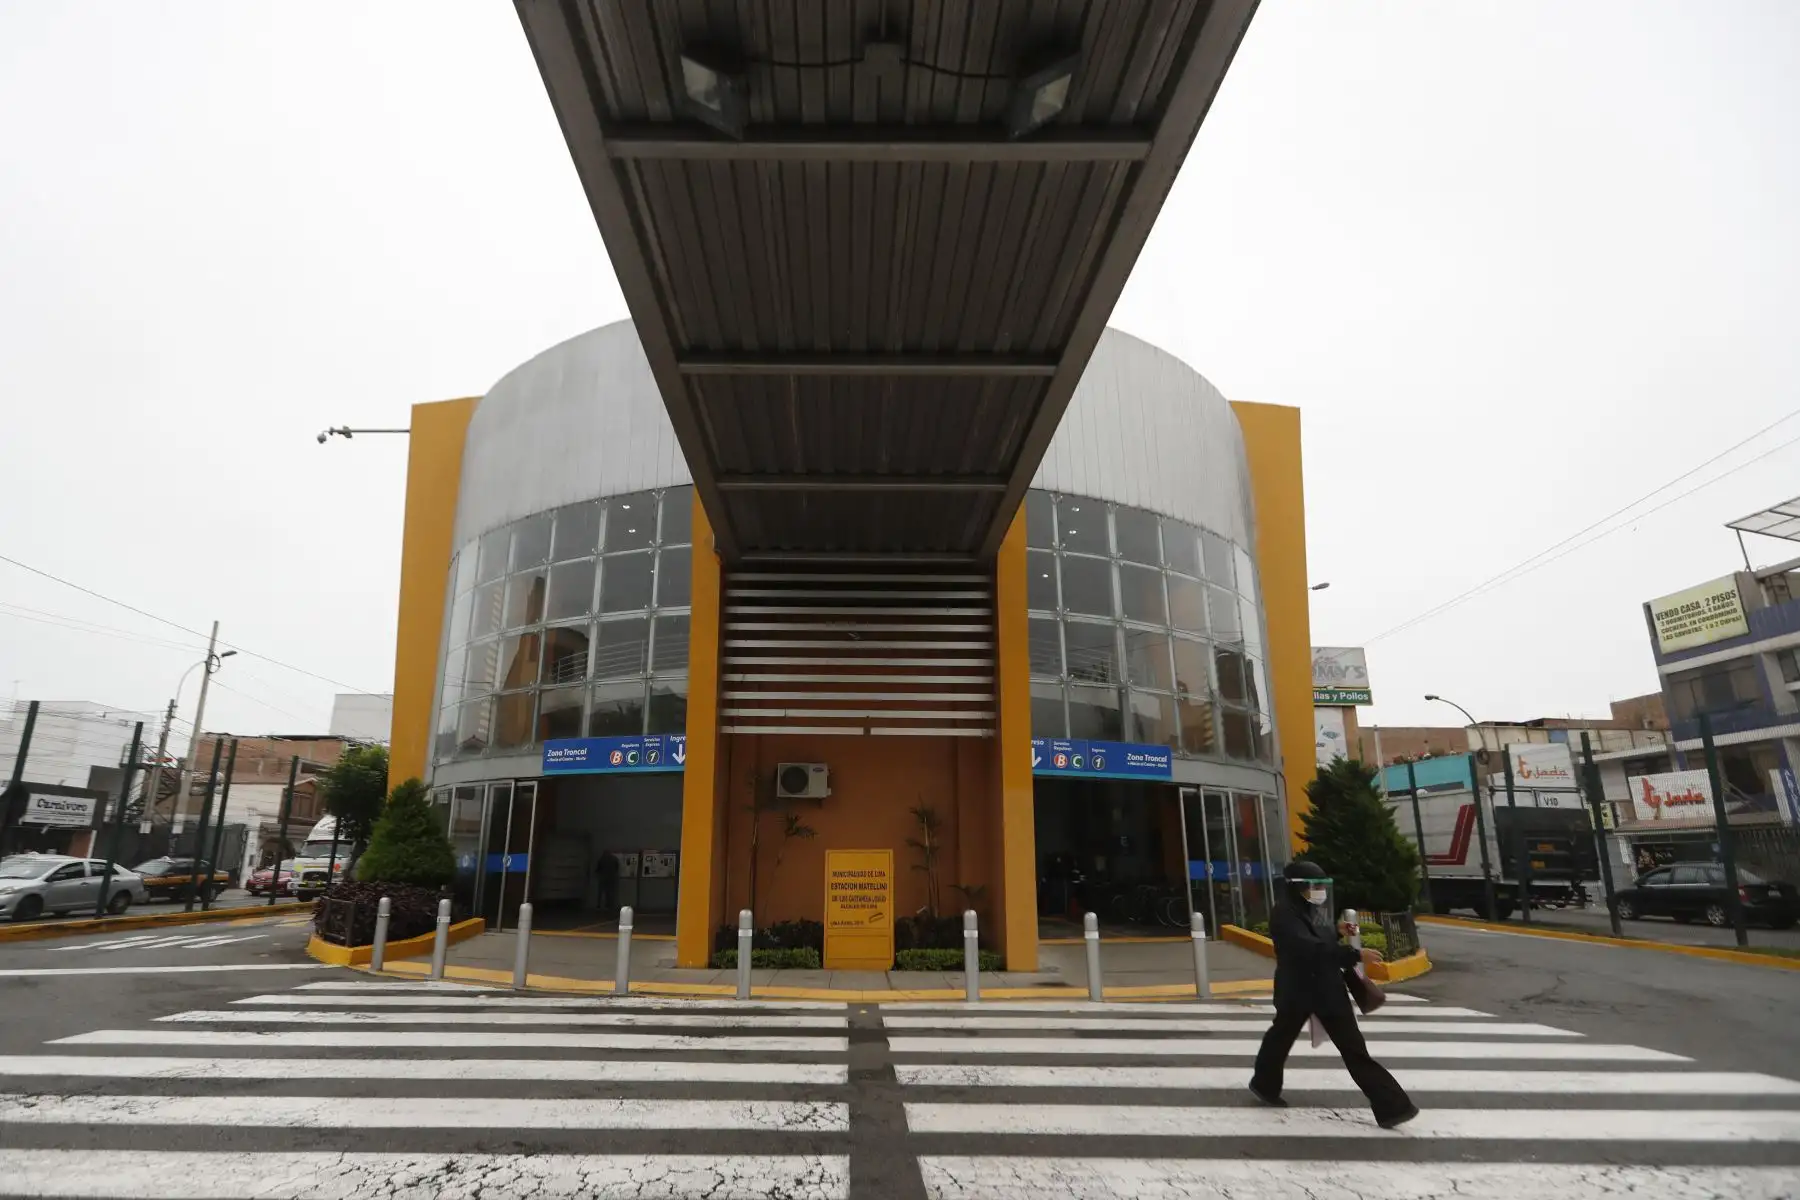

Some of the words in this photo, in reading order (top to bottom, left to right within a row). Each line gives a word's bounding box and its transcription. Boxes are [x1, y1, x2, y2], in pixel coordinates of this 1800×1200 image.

[1655, 607, 1679, 621] VENDO
[1705, 597, 1711, 606] 2
[1711, 589, 1737, 605] PISOS
[1313, 691, 1330, 700] llas
[1331, 693, 1338, 702] y
[1339, 691, 1369, 700] Pollos
[547, 749, 563, 757] Zona
[564, 747, 587, 756] Troncal
[1127, 753, 1143, 761] Zona
[1144, 754, 1168, 762] Troncal
[875, 869, 886, 878] LIMA
[831, 882, 858, 890] ESTACION
[859, 882, 888, 890] MATELLINI
